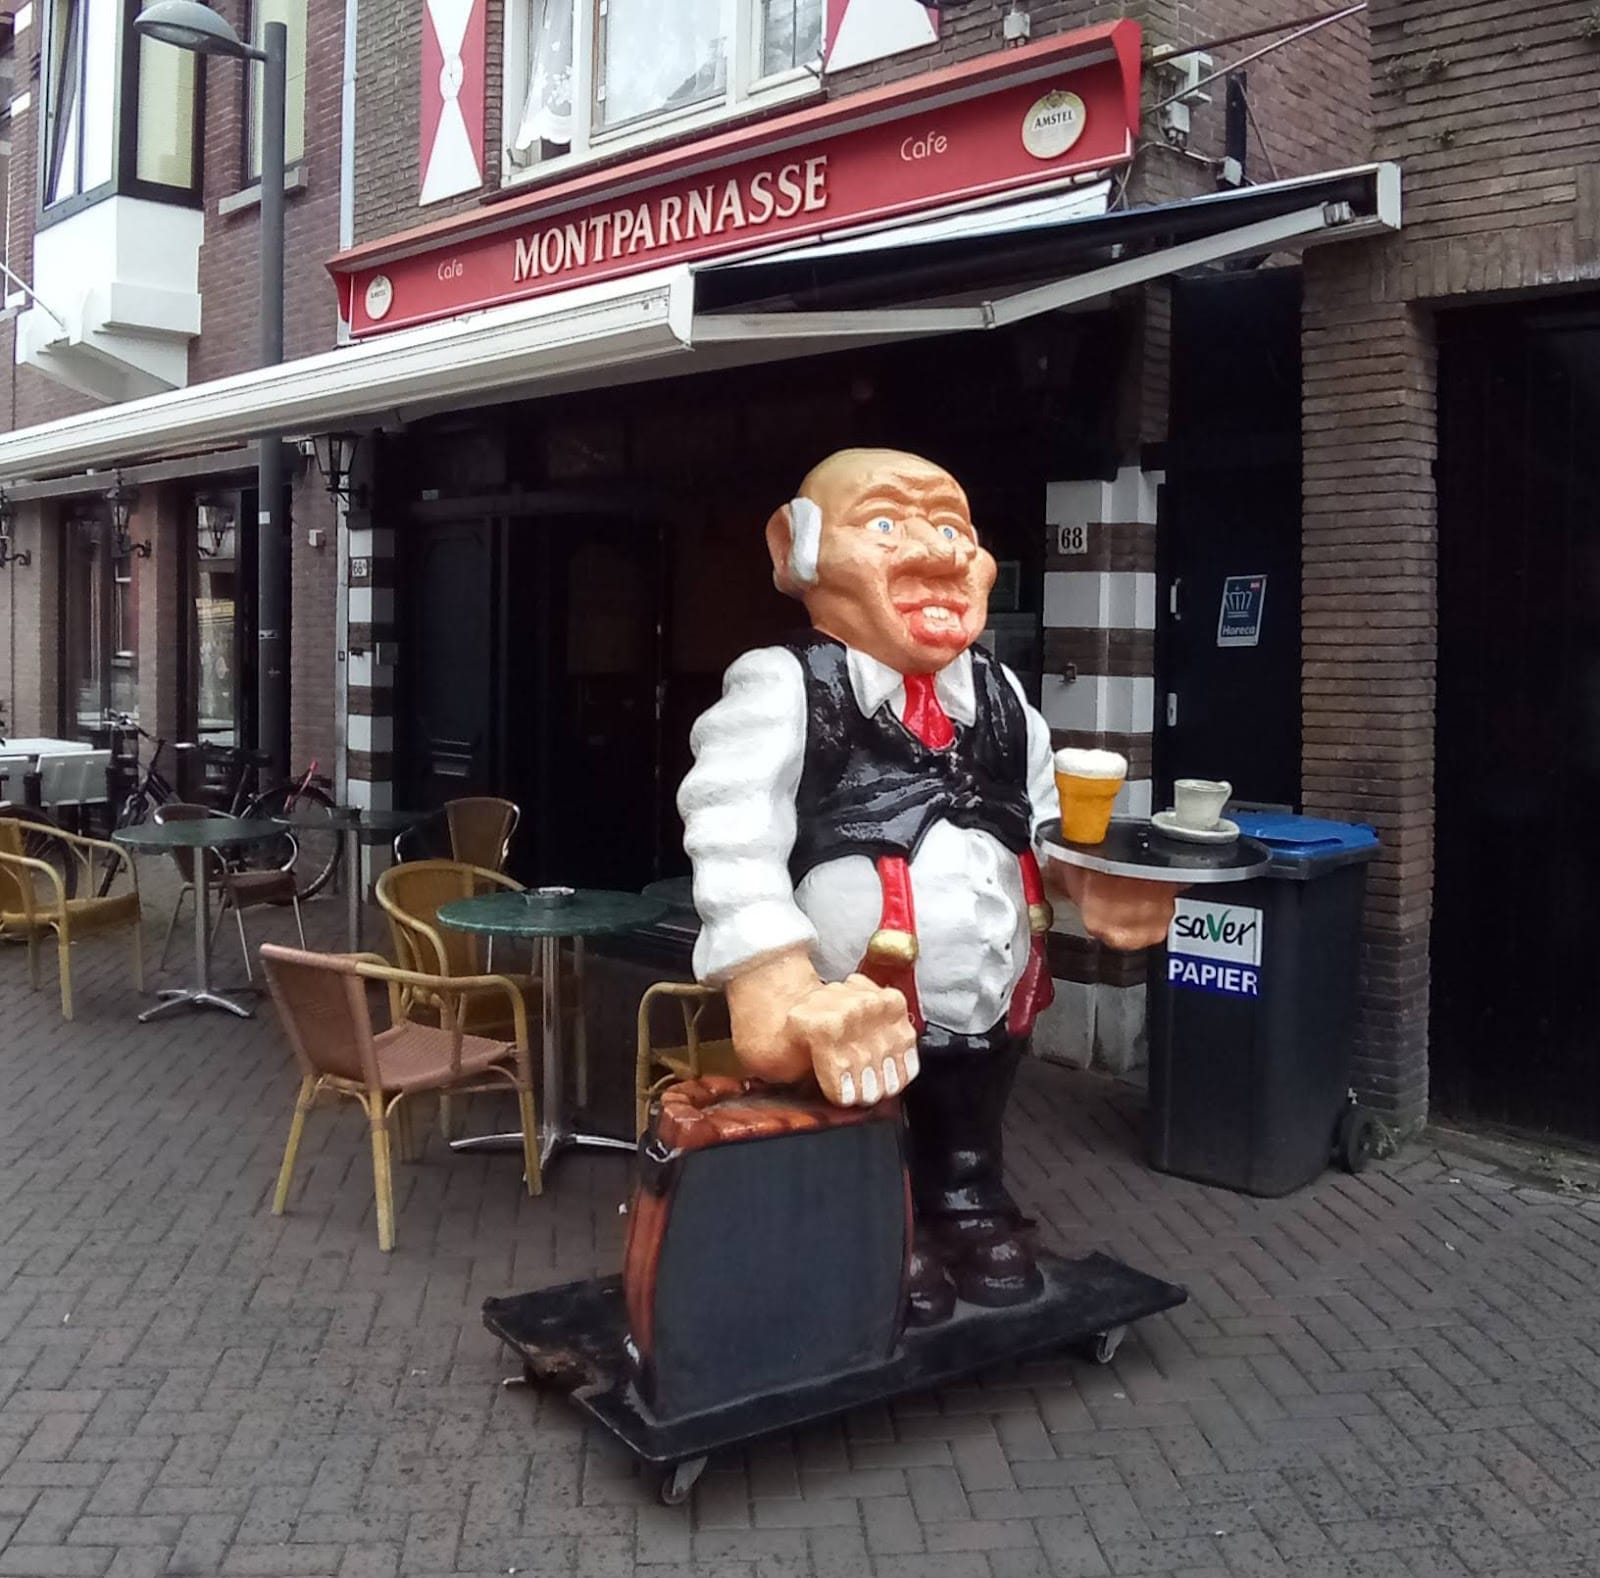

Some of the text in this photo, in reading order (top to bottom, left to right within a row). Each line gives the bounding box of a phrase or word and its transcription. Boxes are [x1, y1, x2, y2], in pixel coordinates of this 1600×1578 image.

[1035, 110, 1073, 129] AMSTEL
[900, 131, 948, 161] Cafe
[513, 155, 828, 282] MONTPARNASSE
[437, 259, 464, 281] Cafe
[1061, 527, 1083, 550] 68
[1168, 958, 1258, 996] PAPIER
